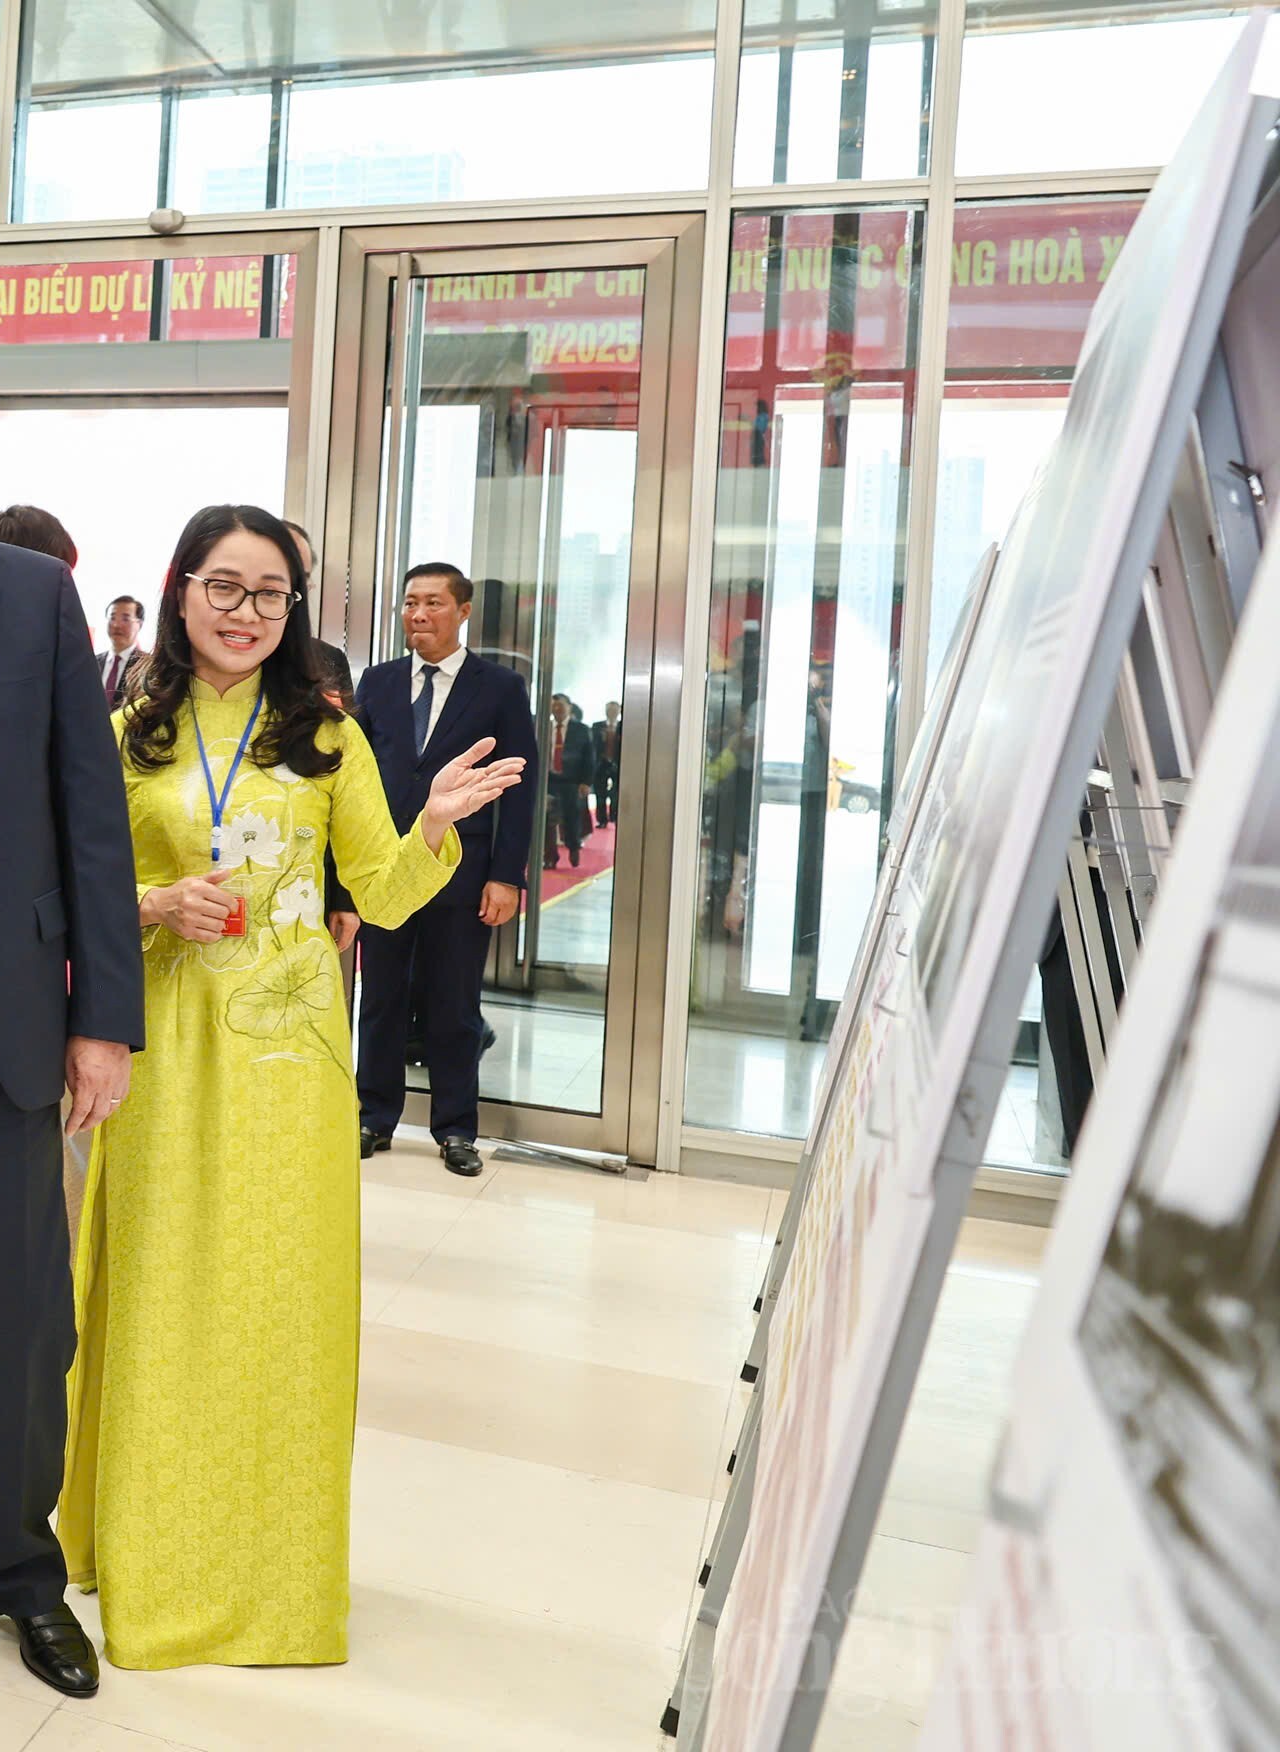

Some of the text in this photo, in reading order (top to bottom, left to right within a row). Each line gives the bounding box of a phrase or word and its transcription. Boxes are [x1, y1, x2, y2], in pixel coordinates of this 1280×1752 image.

[23, 263, 83, 315] BIỂU
[89, 271, 129, 321] DỰ
[171, 258, 207, 310] KỶ
[214, 260, 262, 317] NIỆ
[1008, 228, 1086, 285] HOÀ
